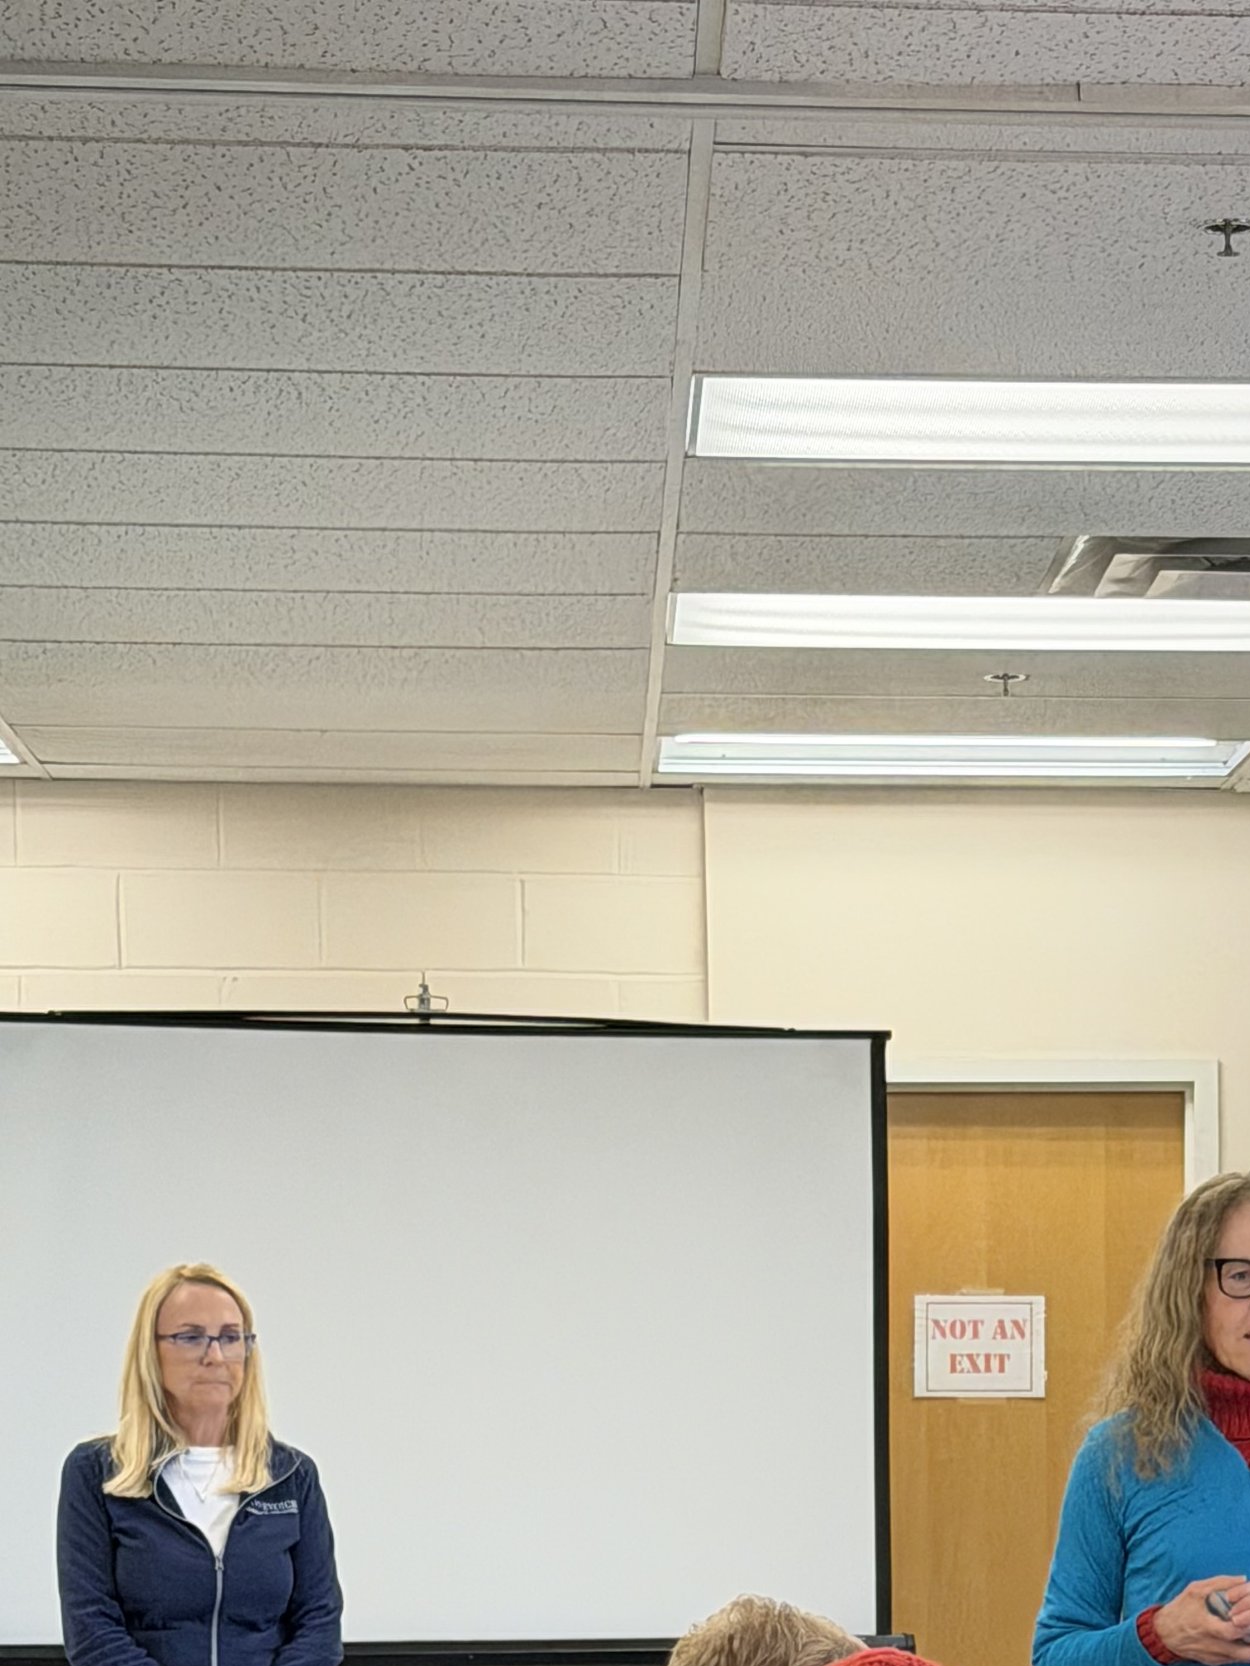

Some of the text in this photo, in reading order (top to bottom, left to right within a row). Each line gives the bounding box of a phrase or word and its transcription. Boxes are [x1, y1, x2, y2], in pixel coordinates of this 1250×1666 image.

[931, 1319, 1027, 1340] NOT AN
[949, 1353, 1011, 1374] EXIT
